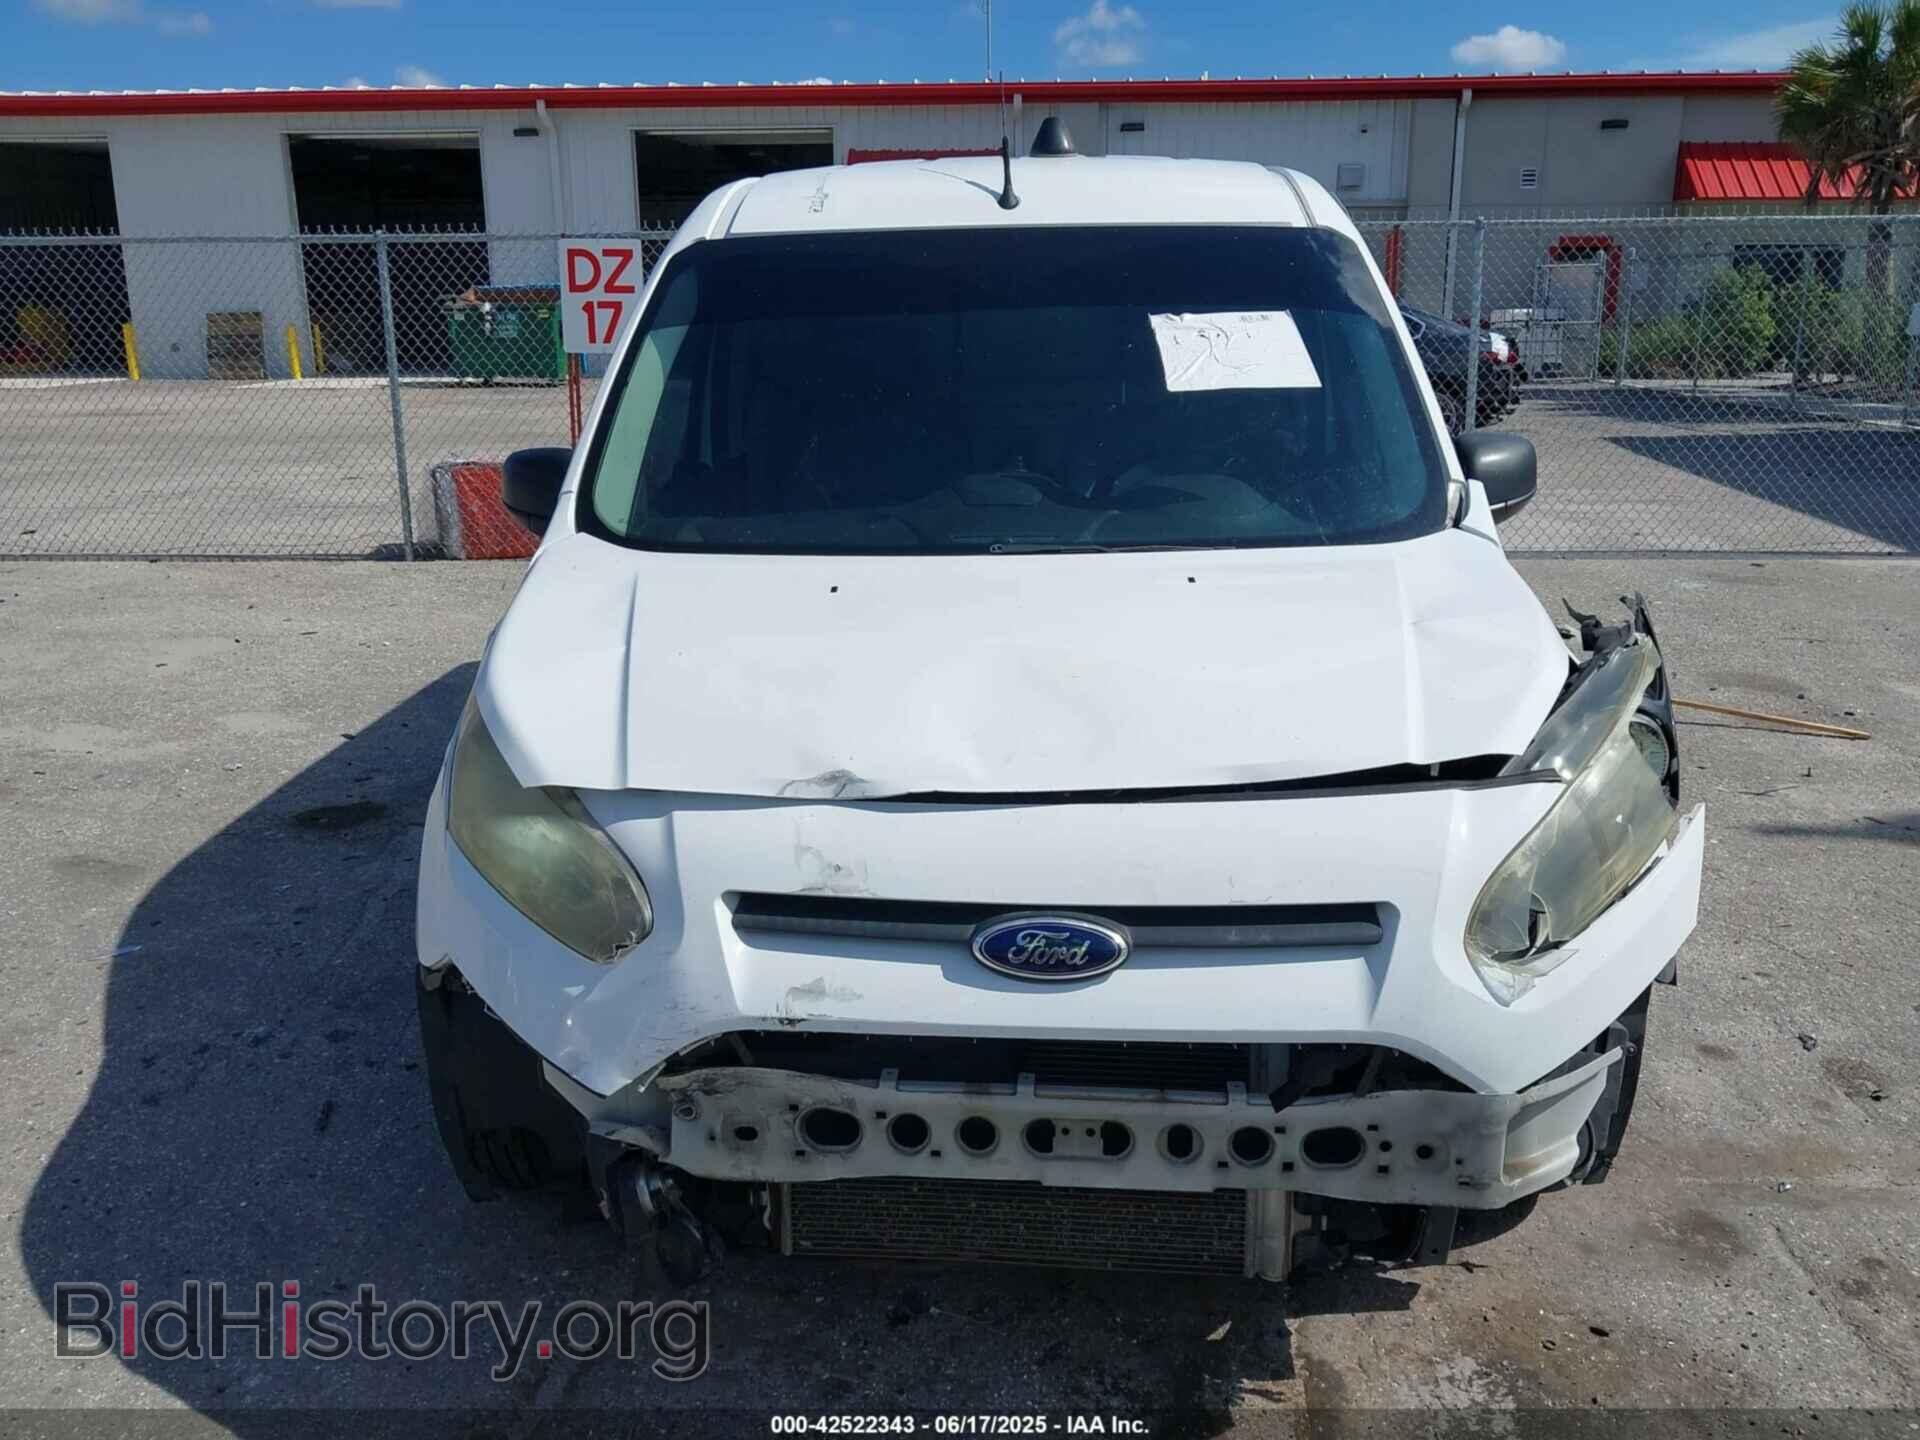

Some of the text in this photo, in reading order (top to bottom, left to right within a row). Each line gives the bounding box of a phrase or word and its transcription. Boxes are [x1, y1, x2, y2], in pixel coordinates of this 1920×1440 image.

[567, 248, 635, 293] DZ
[582, 301, 623, 344] 17
[1007, 929, 1091, 966] Ford
